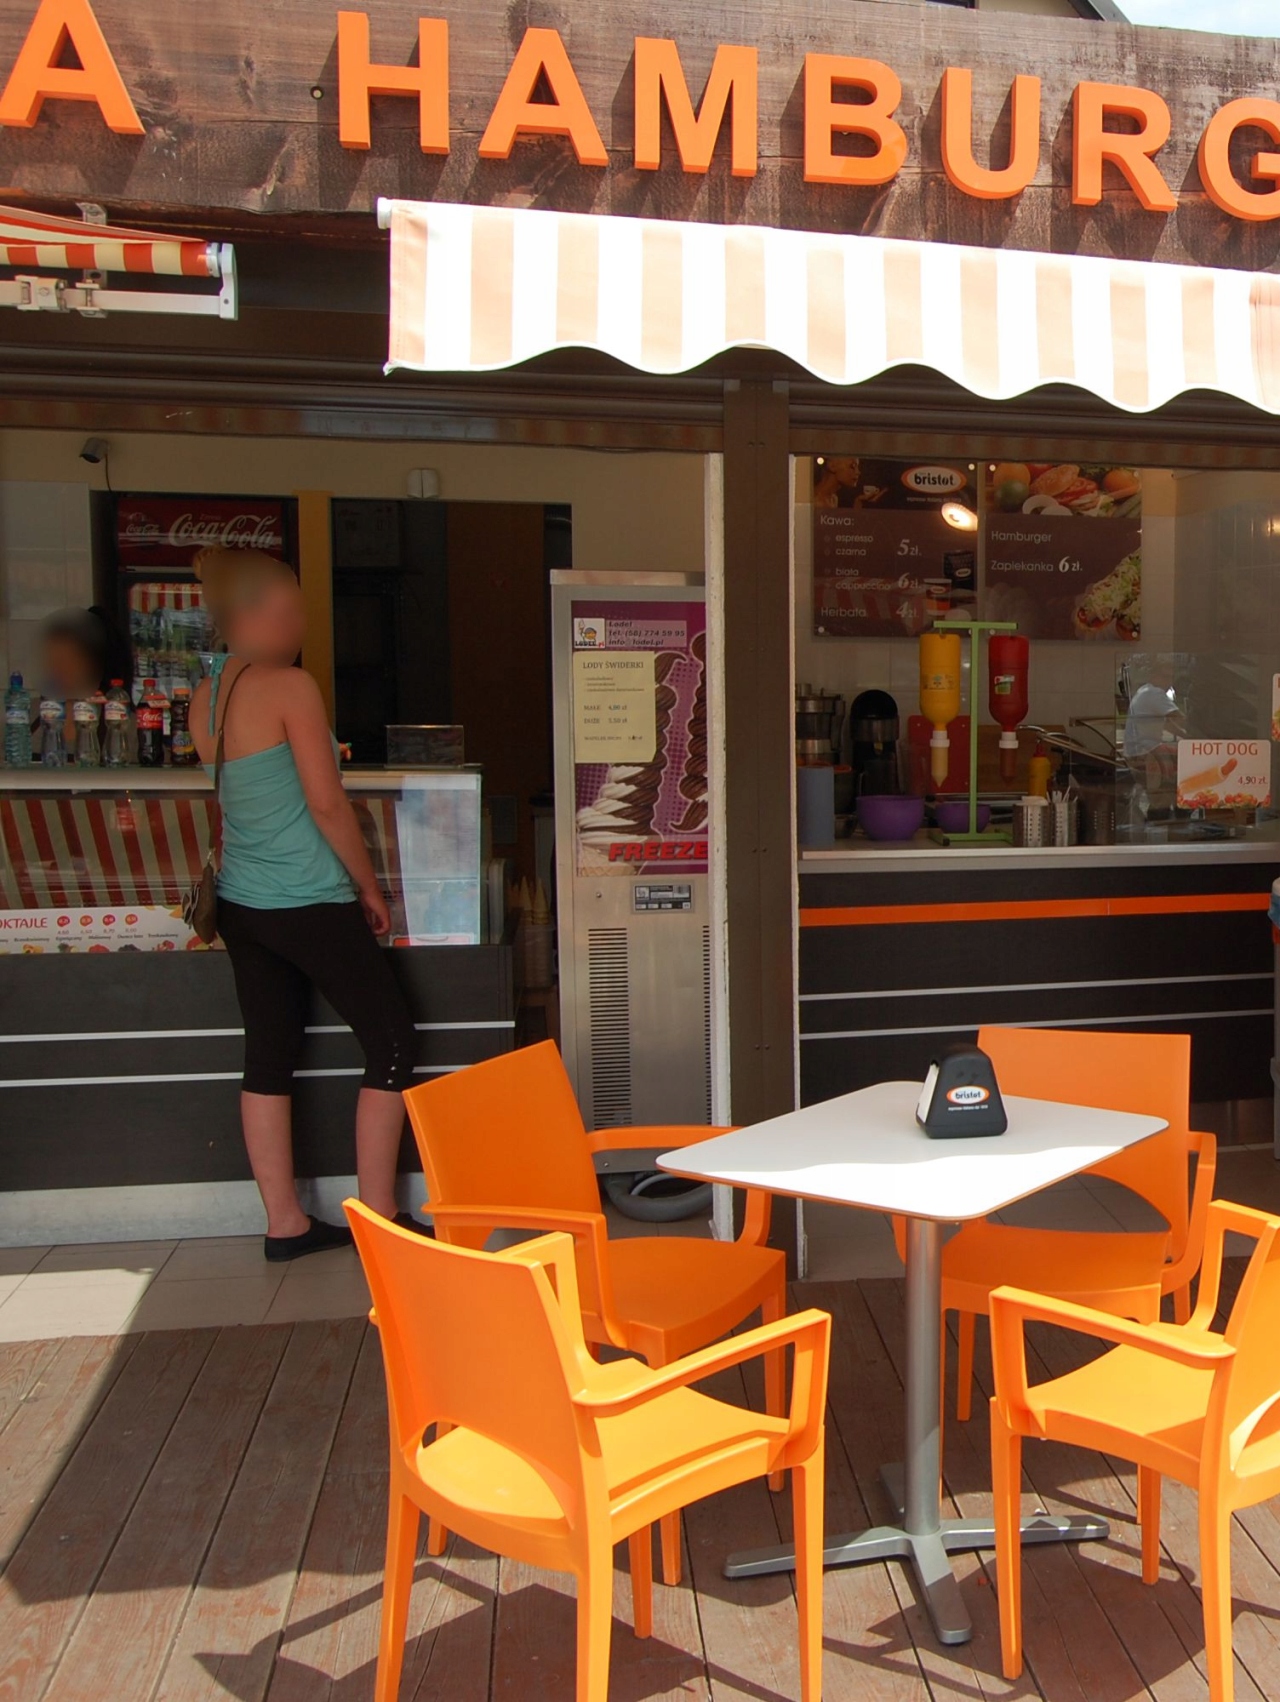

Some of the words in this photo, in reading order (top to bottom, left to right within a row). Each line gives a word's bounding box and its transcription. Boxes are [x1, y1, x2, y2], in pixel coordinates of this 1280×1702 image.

[914, 472, 955, 486] bristot
[820, 515, 855, 526] Kawa:
[169, 513, 277, 549] Coca-Cola
[991, 530, 1052, 544] Hamburger
[835, 534, 874, 544] espresso
[835, 548, 867, 557] czarna
[991, 559, 1054, 572] Zapiekanka
[1058, 555, 1071, 573] 6
[835, 582, 890, 592] cappuccino
[820, 606, 867, 618] Herbata
[583, 661, 604, 669] LODY
[605, 660, 644, 669] ŚWIDERKI
[1191, 742, 1223, 756] HOT
[1226, 742, 1259, 756] DOG
